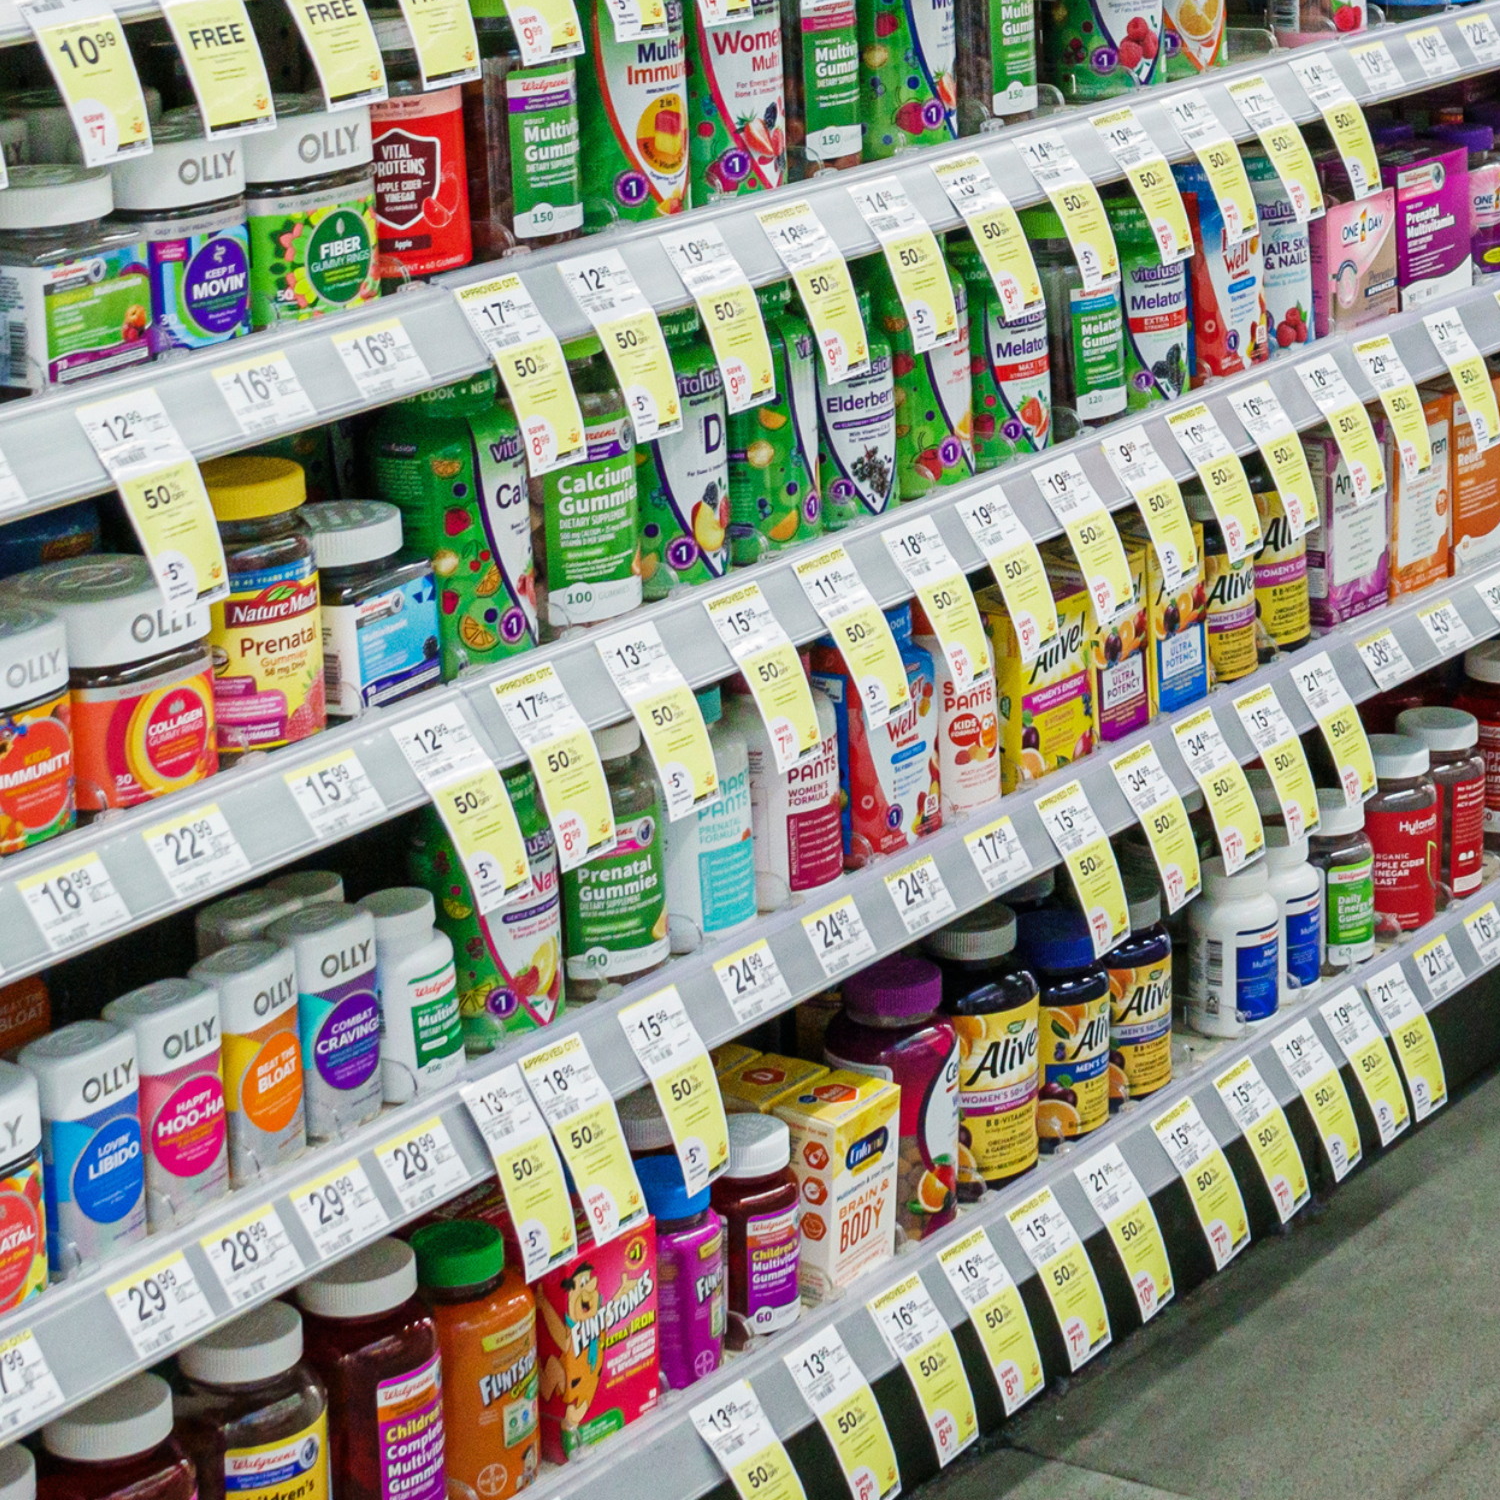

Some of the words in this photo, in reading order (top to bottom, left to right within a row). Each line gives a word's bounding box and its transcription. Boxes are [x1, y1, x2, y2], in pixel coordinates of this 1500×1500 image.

[189, 22, 243, 50] FREE
[298, 124, 359, 165] OLLY
[821, 131, 841, 146] 150
[381, 144, 412, 160] VITAL
[178, 149, 236, 187] OLLY
[532, 210, 554, 224] 150
[1406, 205, 1440, 226] Prenatal
[1407, 214, 1455, 239] Multivitamin
[320, 236, 361, 259] FIBER
[1223, 243, 1249, 275] Well
[205, 268, 226, 280] KEEP
[557, 462, 633, 494] Calcium
[567, 590, 592, 605] 100
[240, 623, 316, 658] Prenatal
[260, 650, 308, 668] Gummies
[943, 689, 993, 712] PANTS
[148, 707, 204, 735] COLLAGEN
[25, 747, 52, 764] KIDS
[116, 774, 133, 787] 30
[787, 756, 836, 785] PANTS
[787, 781, 829, 798] WOMEN'S
[788, 792, 831, 808] FORMULA
[578, 857, 652, 884] Prenatal
[579, 873, 658, 902] Gummies
[321, 938, 371, 978] OLLY
[586, 952, 608, 968] 90
[254, 972, 295, 1017] OLLY
[331, 1008, 373, 1034] COMBAT
[163, 1016, 217, 1060] OLLY
[257, 1055, 281, 1078] BEAT
[281, 1045, 296, 1064] THE
[82, 1058, 135, 1104] OLLY
[258, 1059, 297, 1093] BLOAT
[175, 1090, 212, 1115] HAPPY
[88, 1141, 139, 1181] LIBIDO
[839, 1186, 877, 1222] BRAIN
[840, 1199, 885, 1254] BODY
[756, 1307, 772, 1324] 60
[232, 1448, 297, 1472] Walgreens
